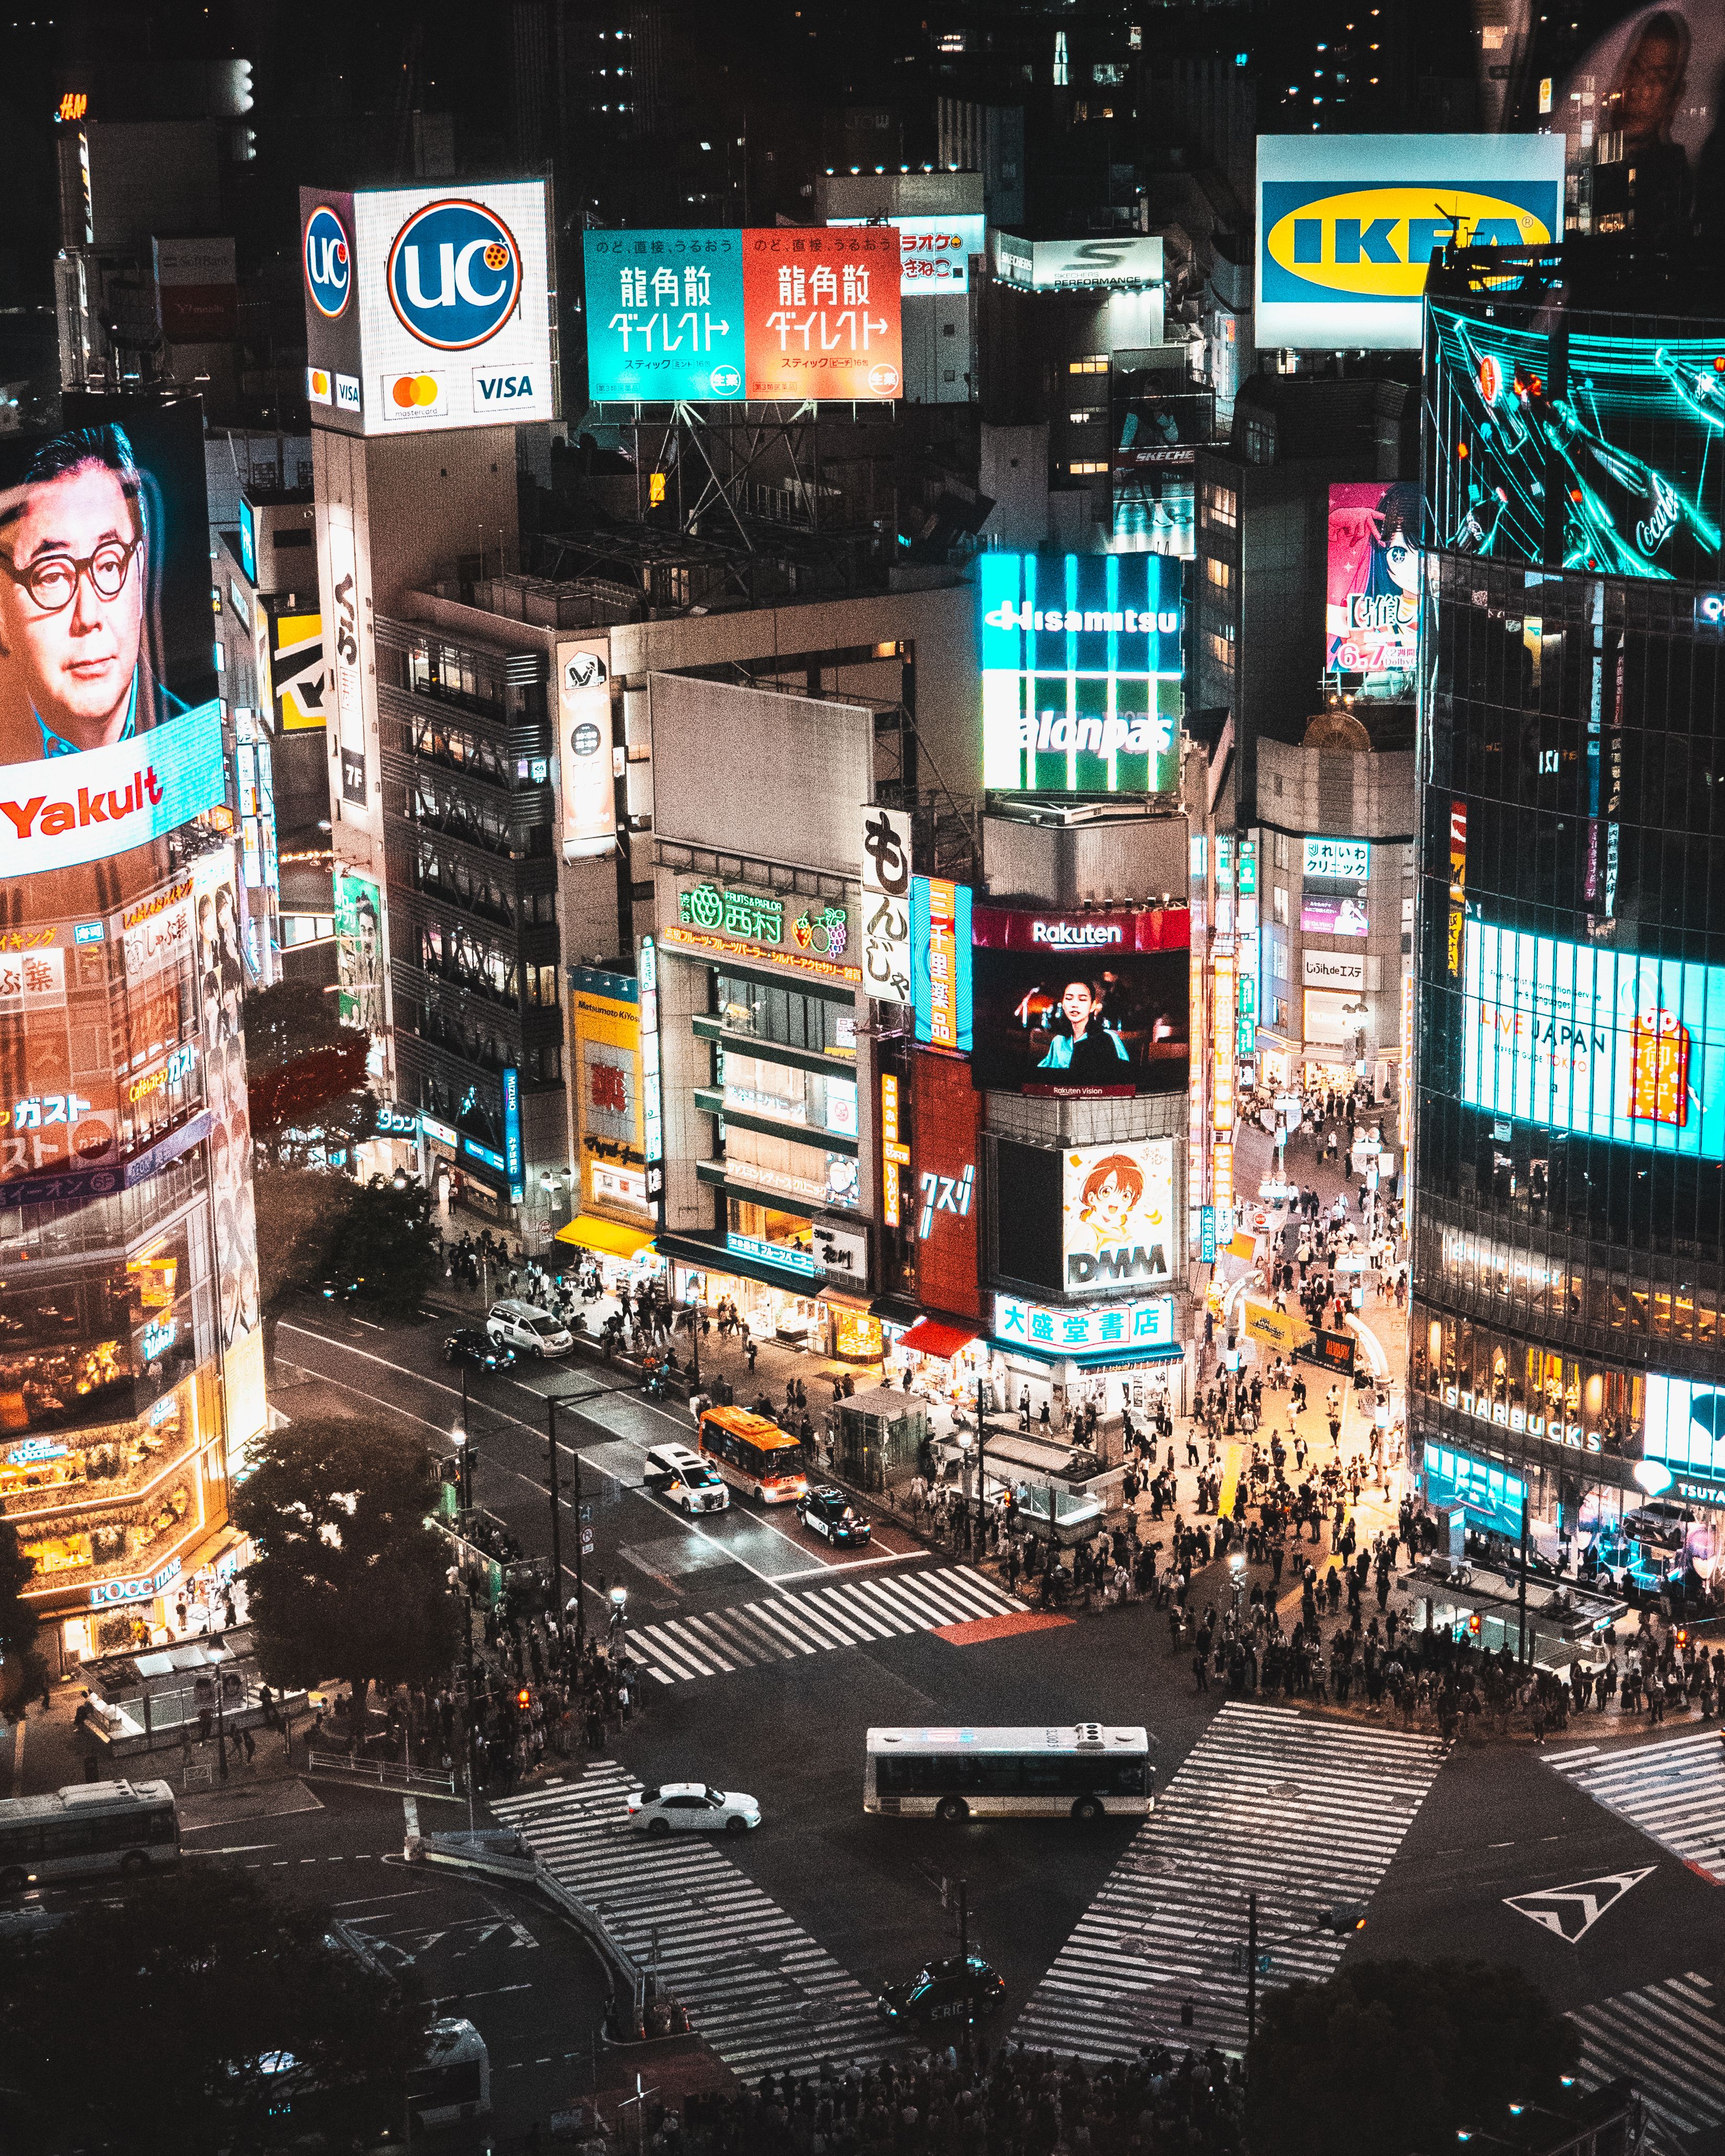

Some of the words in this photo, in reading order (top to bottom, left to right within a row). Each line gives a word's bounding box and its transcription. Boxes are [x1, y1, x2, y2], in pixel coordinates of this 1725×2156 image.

[60, 94, 86, 119] H&M
[597, 240, 732, 255] のど、直接、うるおう
[754, 239, 891, 252] のど、直接、うるおう
[1001, 252, 1032, 271] SKECHERS
[620, 266, 711, 307] 龍角散
[778, 264, 870, 306] 龍角散
[1054, 276, 1141, 287] PERFORMANCE
[608, 312, 730, 352] ダイレクト
[766, 311, 888, 351] ダイレクト
[625, 359, 671, 369] スティック
[781, 358, 829, 368] スティック
[477, 376, 533, 400] VISA
[713, 373, 739, 387] 生薬
[871, 372, 896, 386] 生薬
[338, 383, 360, 403] VISA
[395, 408, 438, 417] mastercard
[1339, 643, 1386, 669] 6.7
[345, 764, 362, 788] 7F
[0, 766, 163, 839] Yakult
[1321, 844, 1366, 860] れいわ
[1307, 860, 1365, 876] クリニック
[680, 893, 690, 924] 渋谷
[864, 811, 910, 1000] もんじゃ
[724, 903, 781, 944] 西村
[1034, 921, 1121, 944] Rakuten
[929, 890, 950, 1039] 三千里薬品
[578, 1000, 619, 1017] Matsumoto
[1482, 1003, 1523, 1035] LIVE
[1531, 1020, 1605, 1053] JAPAN
[167, 1043, 200, 1084] ガスト
[1546, 1053, 1587, 1072] TOKYO
[507, 1076, 516, 1111] MIZUHO
[1053, 1086, 1080, 1095] Rakuten
[1082, 1086, 1103, 1095] Vision
[15, 1094, 91, 1129] ガスト
[919, 1164, 975, 1239] クスリ
[1068, 1243, 1167, 1285] DMM
[1005, 1306, 1159, 1343] 大盛堂書店
[1445, 1385, 1601, 1451] STARBUCKS
[92, 1554, 183, 1605] L'OCCITANE
